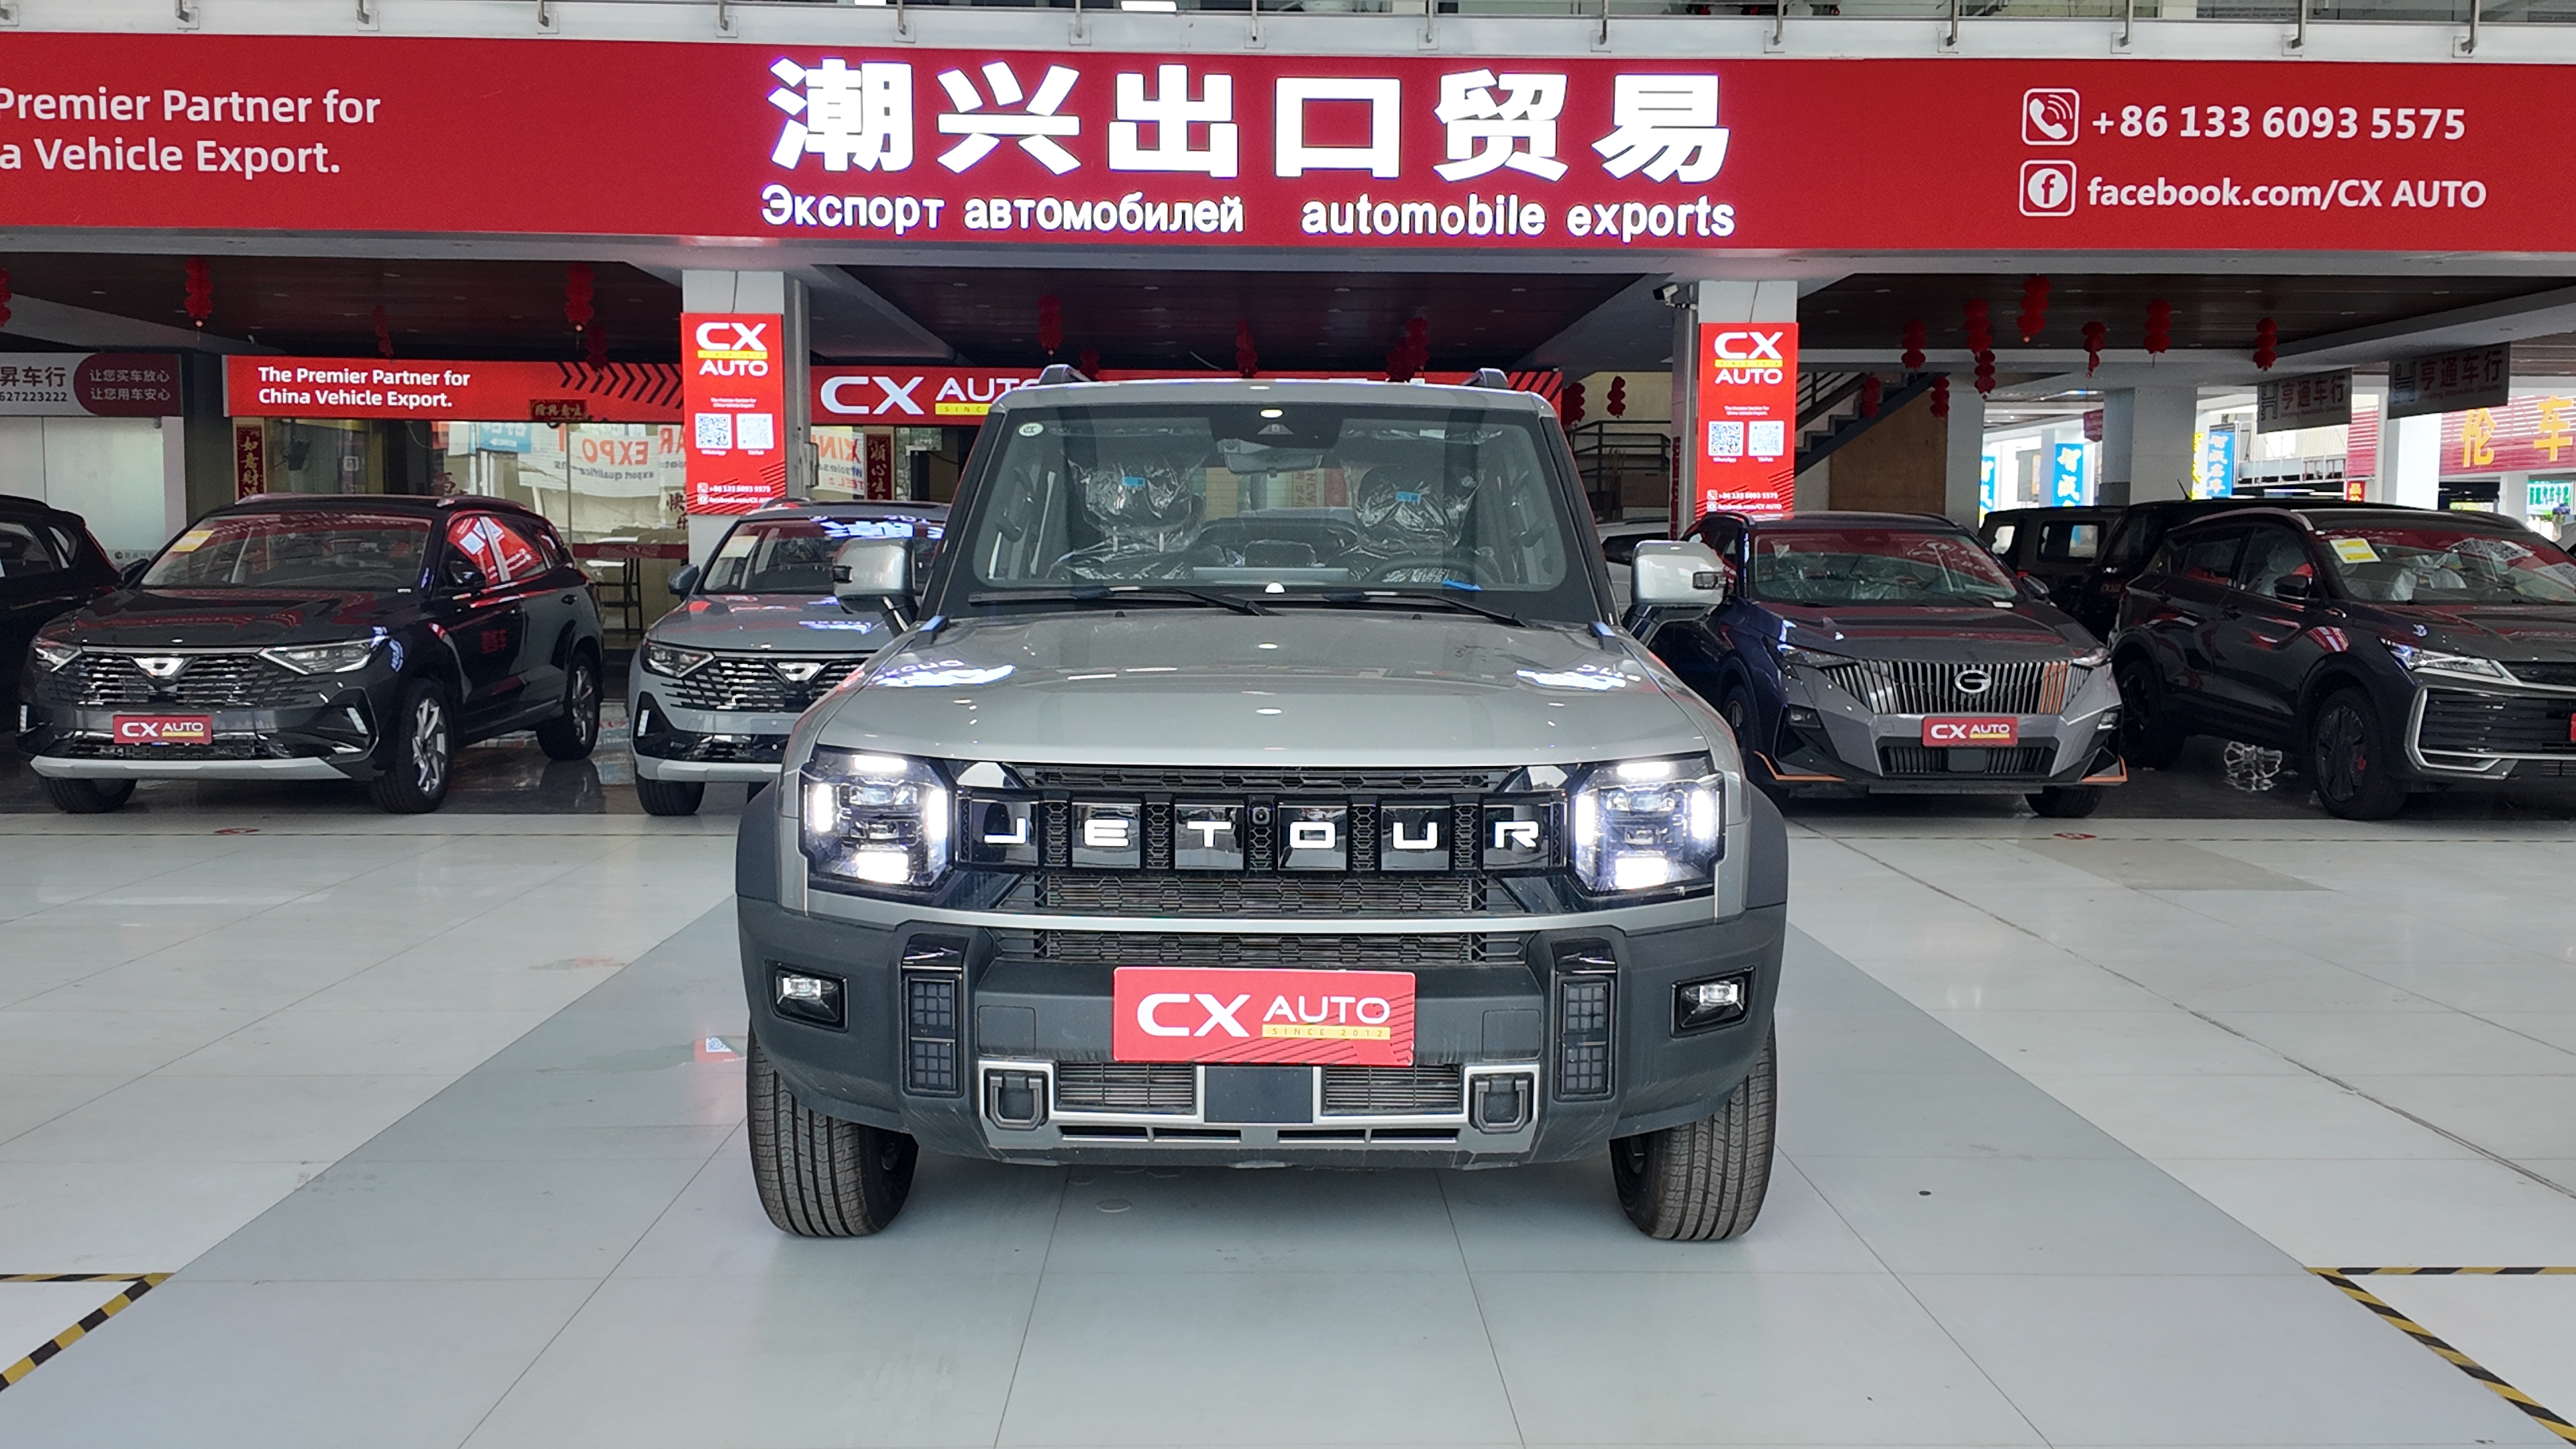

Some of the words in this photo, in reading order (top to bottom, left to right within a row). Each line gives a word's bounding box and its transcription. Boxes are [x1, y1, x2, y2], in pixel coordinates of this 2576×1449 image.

[0, 87, 150, 121] Premier
[164, 90, 312, 123] Partner
[323, 89, 380, 123] for
[767, 58, 1731, 183] 潮兴出口贸易
[2092, 105, 2167, 137] +86
[2180, 105, 2250, 138] 133
[2263, 107, 2358, 138] 6093
[2371, 107, 2465, 140] 5575
[34, 136, 182, 171] Vehicle
[197, 140, 339, 180] Export.
[2087, 176, 2383, 211] facebook.com/CX
[2391, 180, 2486, 208] AUTO
[761, 184, 945, 235] Экспорт
[964, 192, 1244, 233] автомобилей
[1301, 193, 1546, 236] automobile
[1567, 195, 1735, 243] exports
[696, 322, 767, 351] CX
[1714, 331, 1783, 360] CX
[89, 369, 170, 382] 让您买车放心
[258, 366, 292, 383] The
[297, 368, 368, 384] Premier
[372, 369, 440, 386] Partner
[443, 370, 471, 386] for
[699, 360, 768, 376] AUTO
[1715, 368, 1783, 384] AUTO
[91, 388, 171, 401] 让您用车安心
[259, 388, 311, 405] China
[315, 389, 382, 406] Vehicle
[387, 391, 453, 410] Export.
[820, 376, 924, 415] CX
[935, 377, 1040, 402] AUT
[121, 722, 158, 737] CX
[162, 722, 204, 732] AUTO
[1931, 724, 1967, 739] CX
[1970, 724, 2010, 733] AUTO
[984, 818, 1539, 849] JETOUR
[1137, 994, 1251, 1037] CX
[1263, 995, 1391, 1024] AUTO
[1272, 1027, 1326, 1036] SINCE
[1340, 1028, 1384, 1038] 2012
